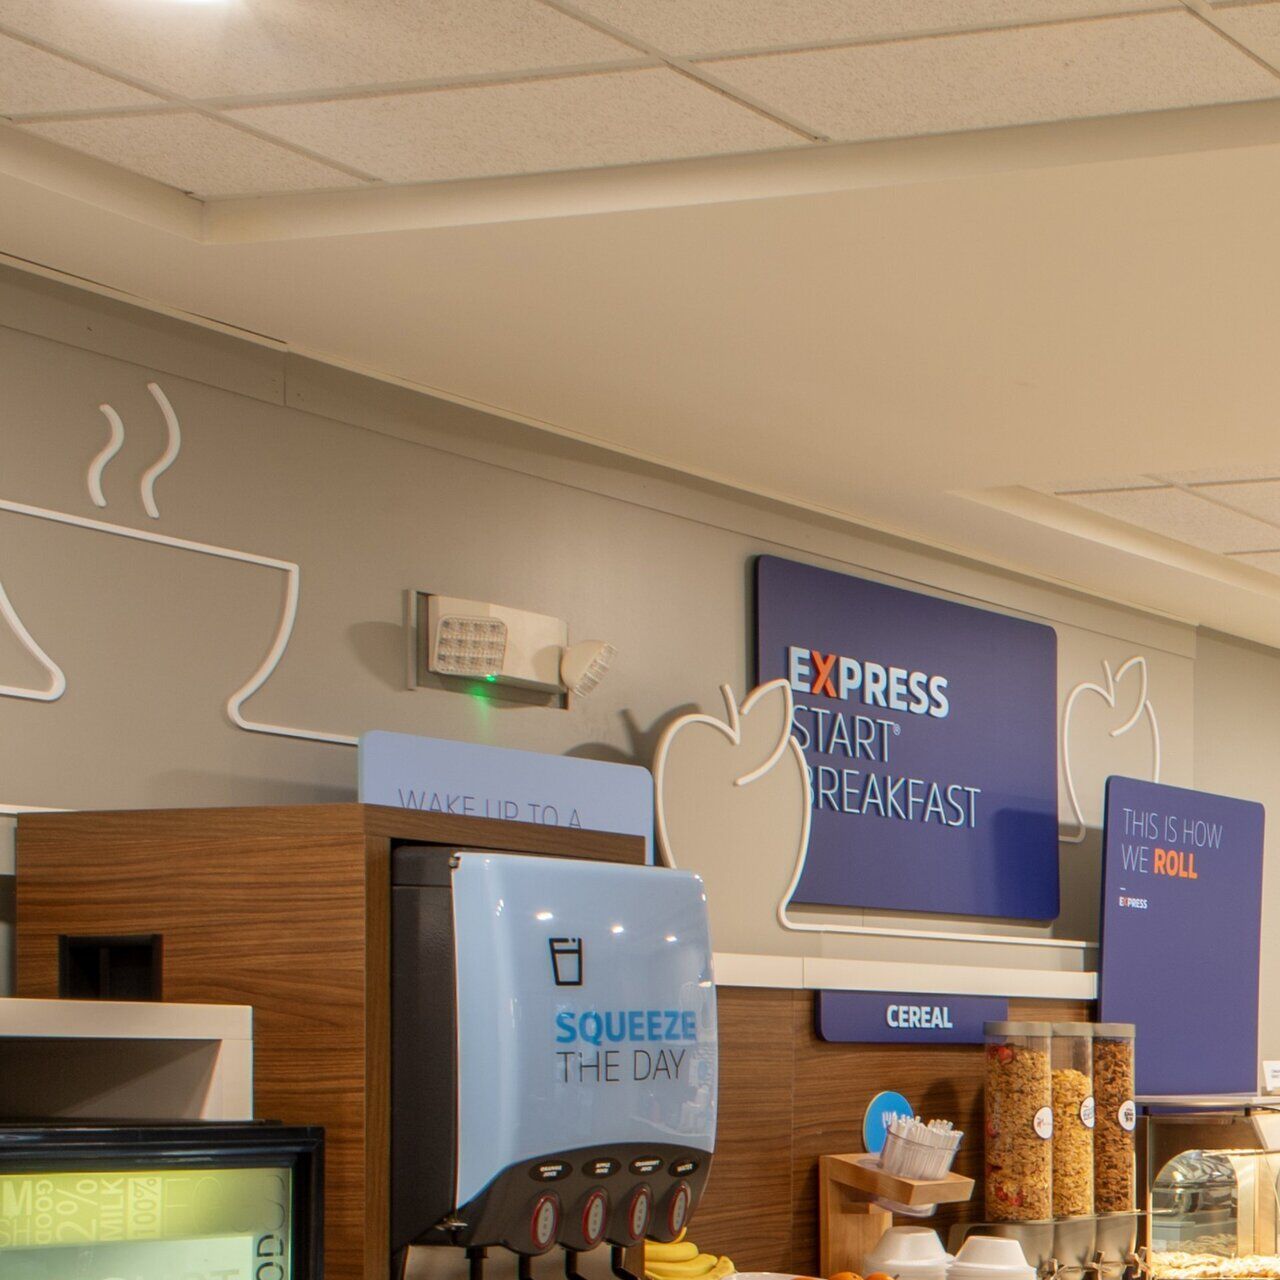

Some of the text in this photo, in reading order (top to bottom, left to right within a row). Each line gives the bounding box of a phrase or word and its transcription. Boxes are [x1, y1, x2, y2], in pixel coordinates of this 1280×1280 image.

[789, 645, 950, 719] EXPRESS
[1123, 807, 1223, 850] THIS IS HOW
[1121, 843, 1199, 880] WE ROLL
[1119, 896, 1149, 910] EXPRESS
[555, 1010, 698, 1043] SQUEEZE
[886, 1004, 954, 1029] CEREAL
[556, 1048, 687, 1084] THE DAY
[101, 1176, 125, 1240] MILK
